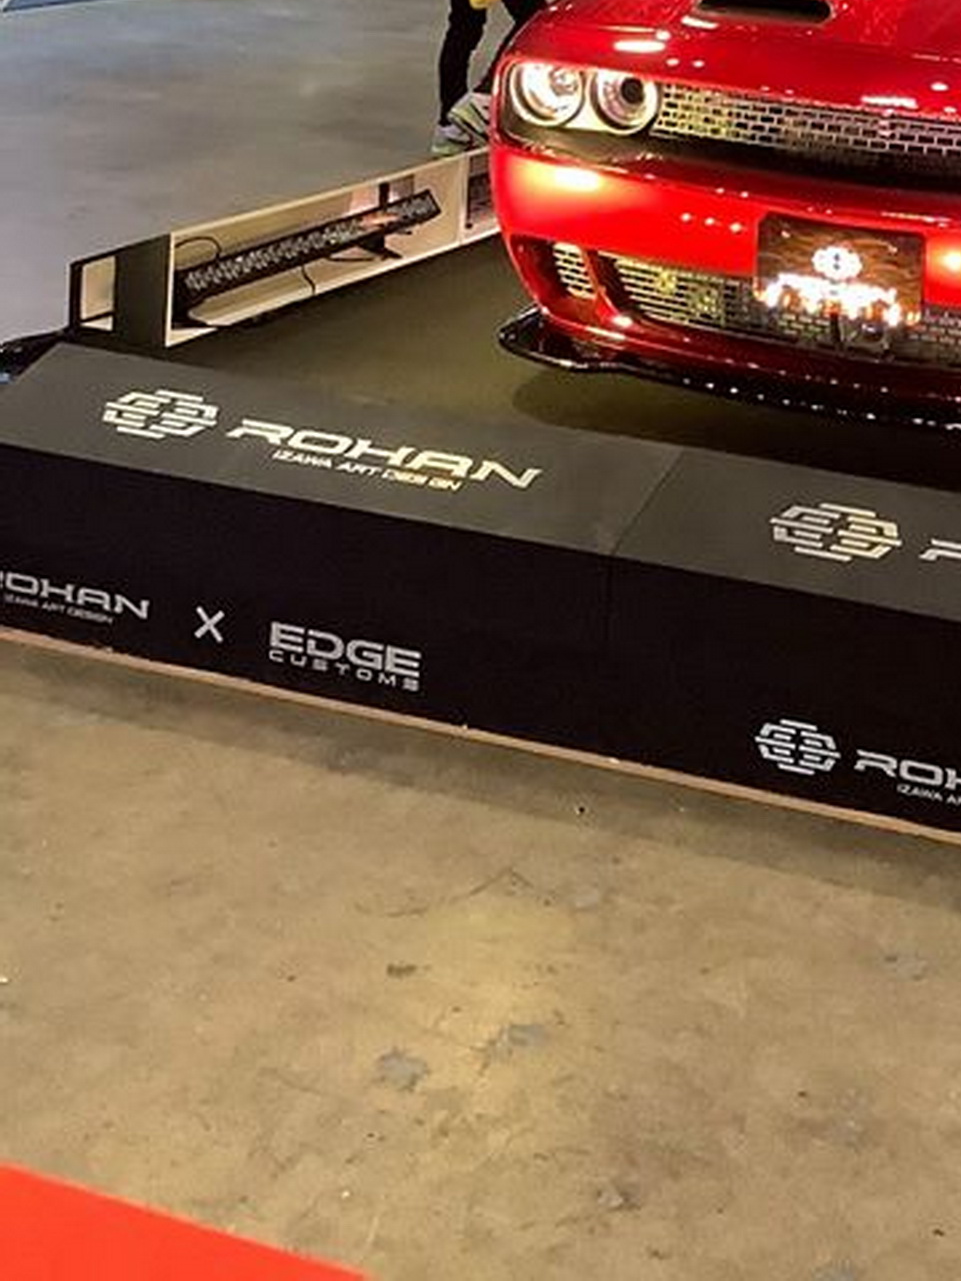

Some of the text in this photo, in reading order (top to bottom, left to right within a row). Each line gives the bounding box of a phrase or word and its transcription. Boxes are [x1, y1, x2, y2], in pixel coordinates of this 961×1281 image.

[225, 417, 544, 489] ROHAN
[272, 448, 463, 492] IZAWA ART DESIGN
[0, 570, 150, 620] OHAN
[269, 620, 423, 678] EDGE
[267, 649, 420, 693] CUSTOMS
[896, 783, 944, 802] IZAWA
